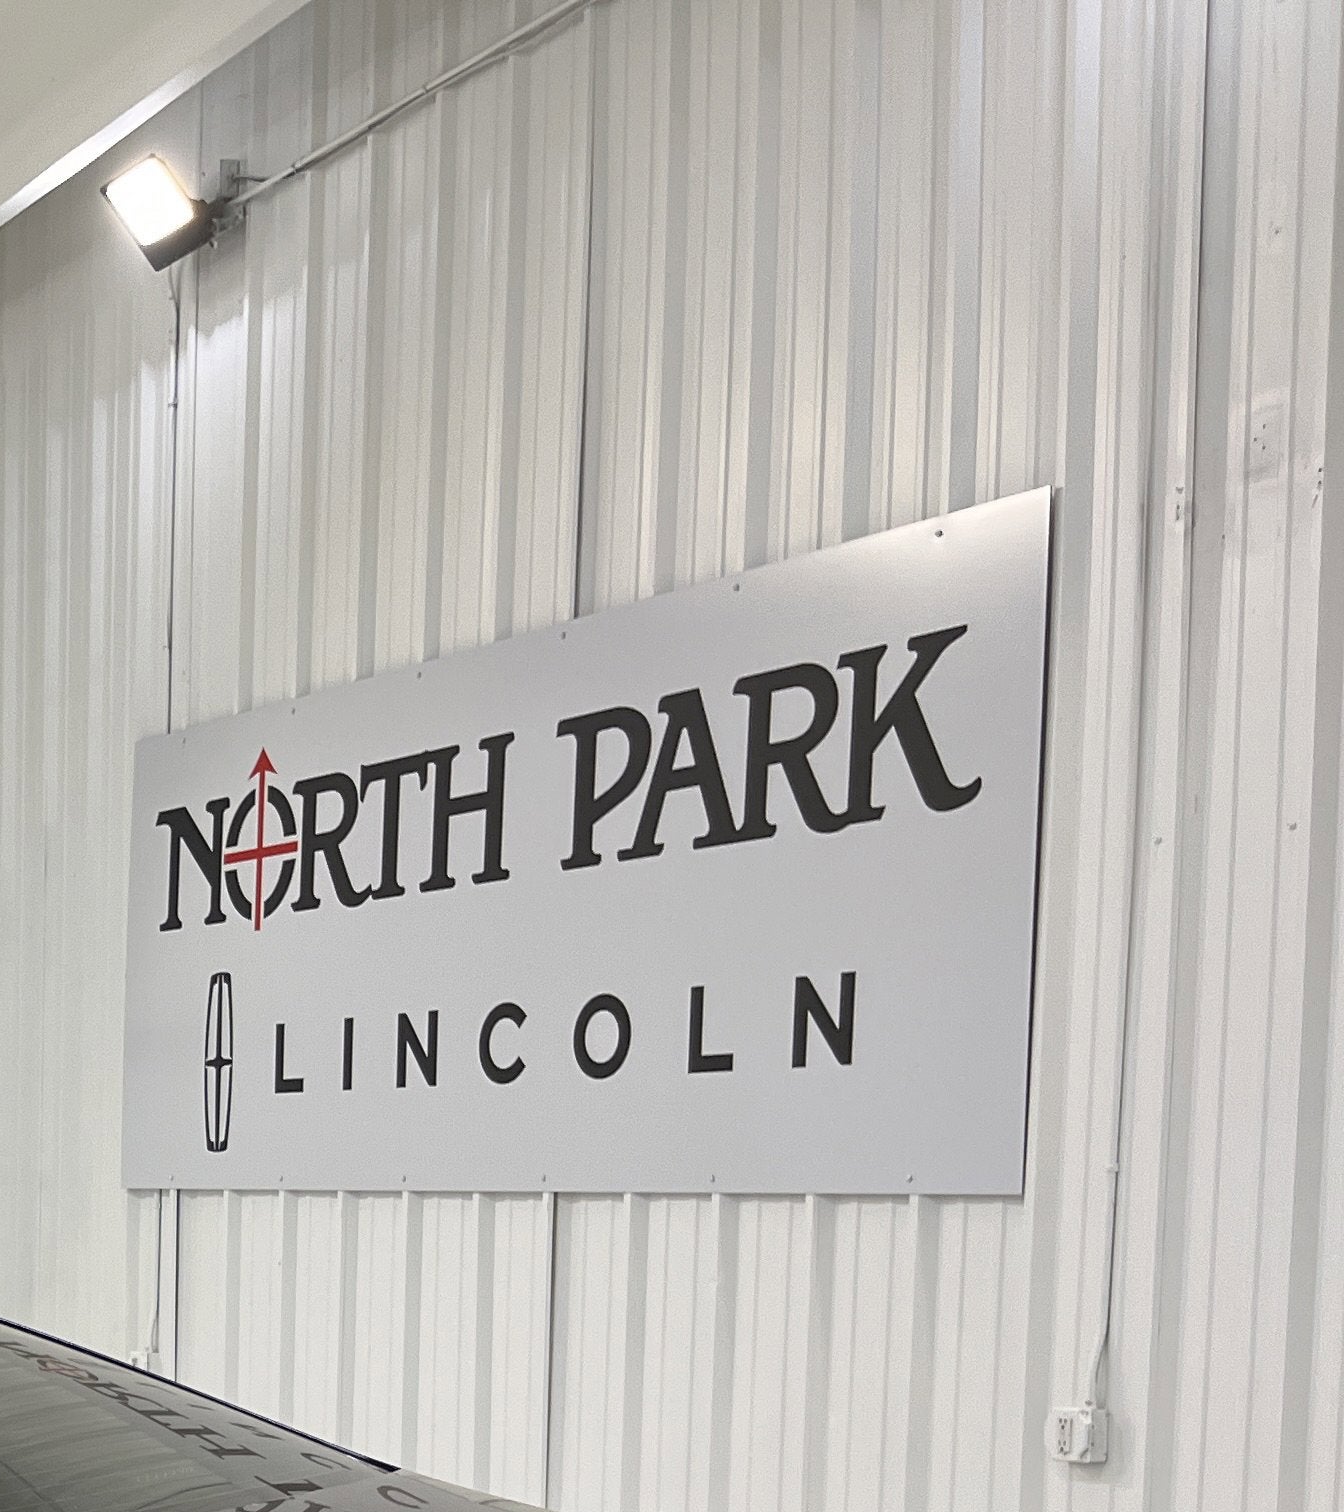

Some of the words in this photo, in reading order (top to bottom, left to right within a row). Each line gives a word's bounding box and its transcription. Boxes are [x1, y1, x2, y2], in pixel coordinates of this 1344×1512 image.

[158, 731, 515, 932] NORTH
[557, 625, 982, 870] PARK
[274, 971, 857, 1094] LINCOLN
